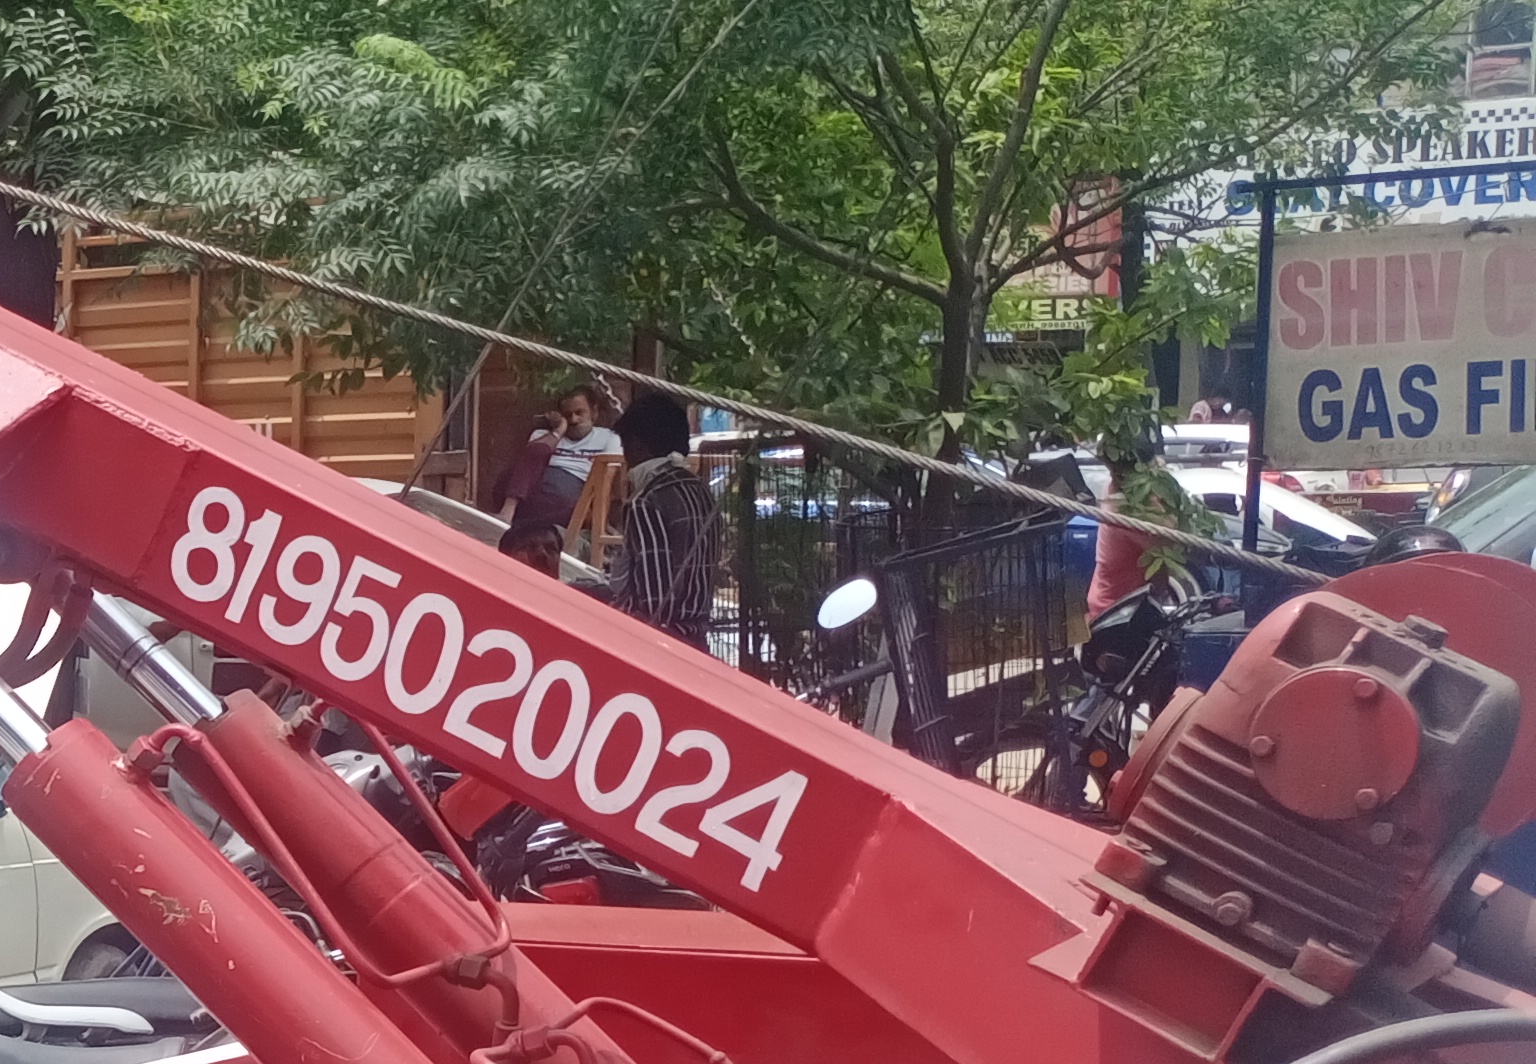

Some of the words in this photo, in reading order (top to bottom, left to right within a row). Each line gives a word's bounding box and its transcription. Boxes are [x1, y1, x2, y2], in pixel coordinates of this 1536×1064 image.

[1279, 250, 1463, 350] SHIV
[1297, 363, 1439, 443] GAS
[1466, 359, 1536, 435] FI
[170, 486, 808, 892] 8195020024
